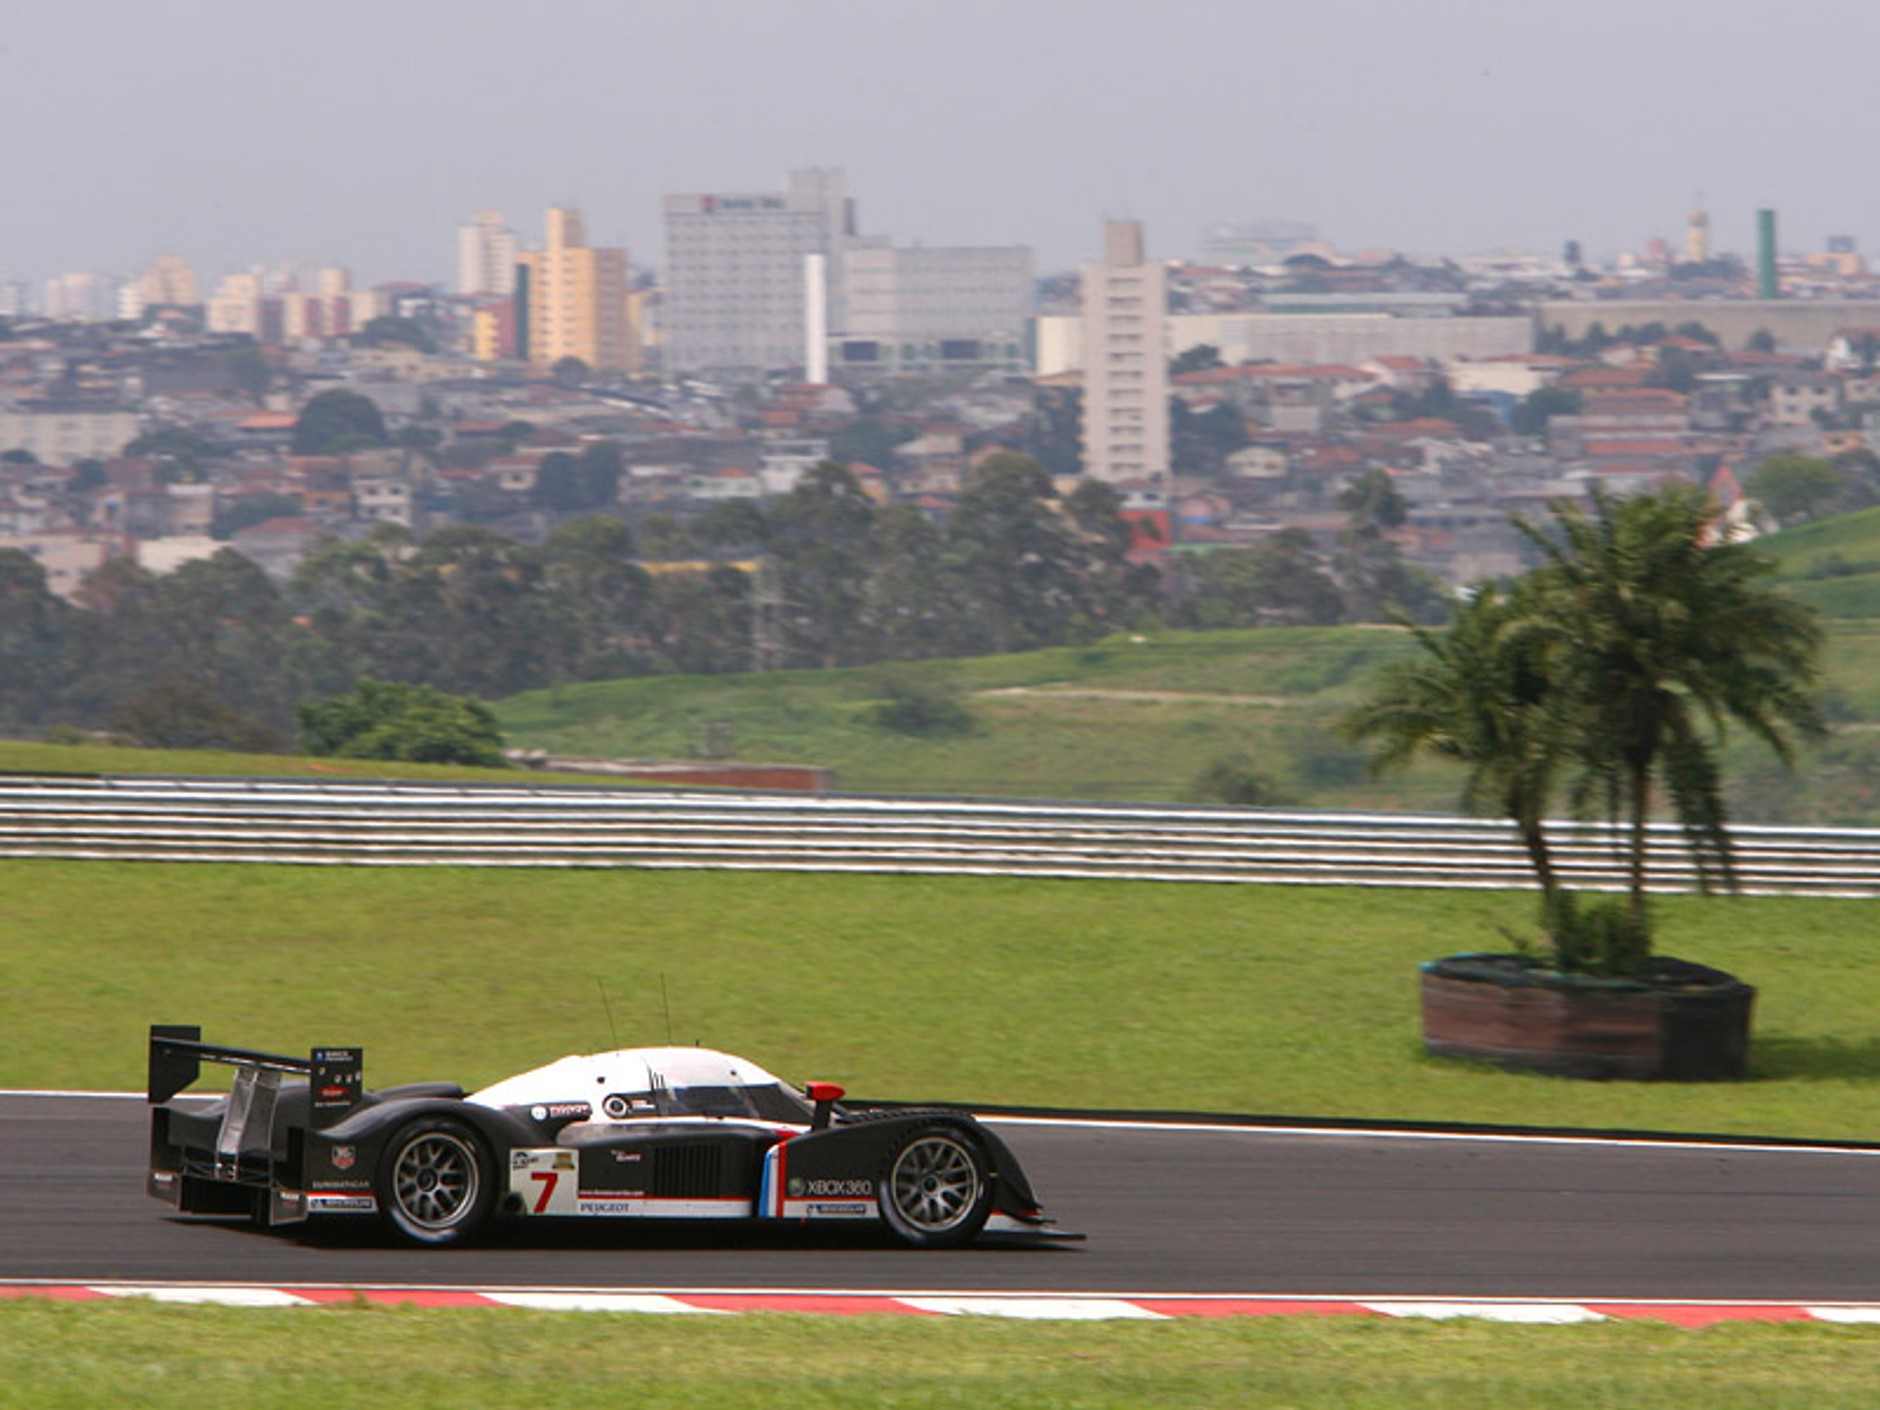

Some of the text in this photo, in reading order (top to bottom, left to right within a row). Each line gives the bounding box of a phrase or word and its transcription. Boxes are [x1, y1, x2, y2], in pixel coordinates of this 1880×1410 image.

[531, 1172, 558, 1214] 7
[807, 1180, 873, 1195] XBOX 360
[580, 1203, 630, 1213] PEUGEOT
